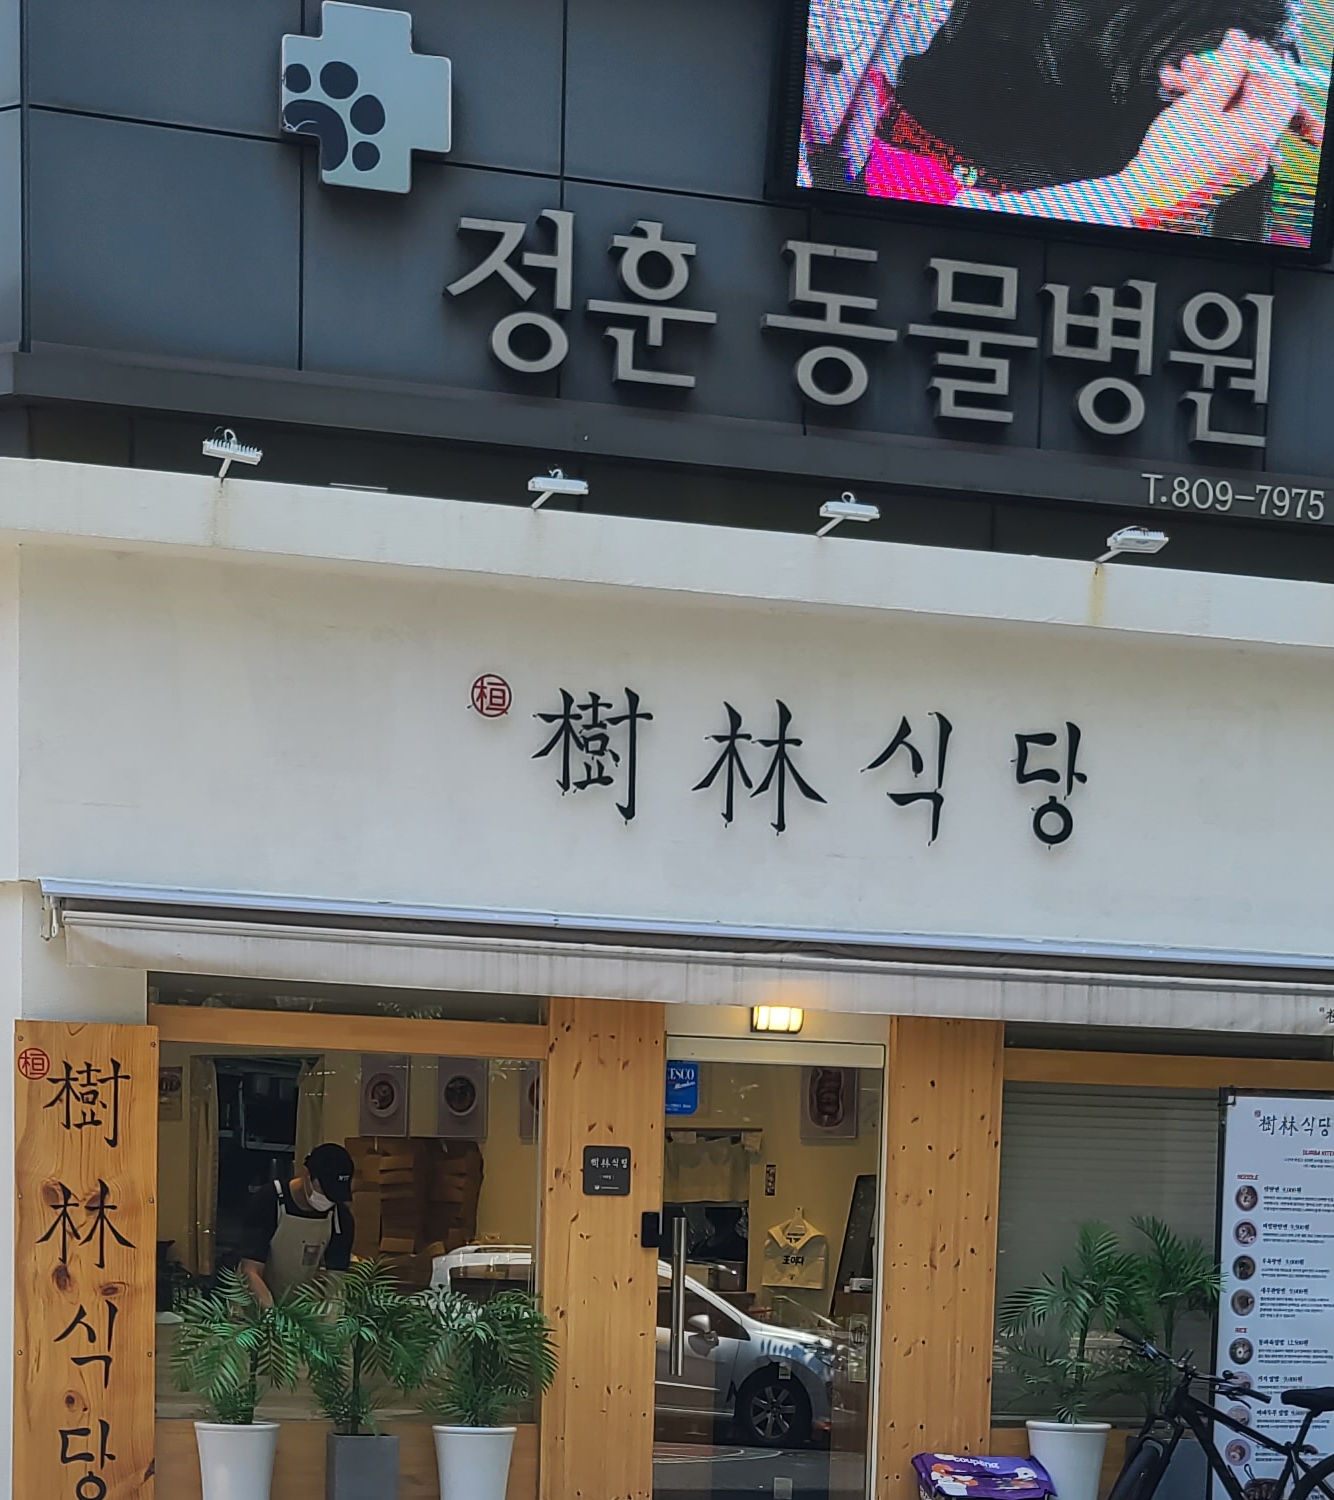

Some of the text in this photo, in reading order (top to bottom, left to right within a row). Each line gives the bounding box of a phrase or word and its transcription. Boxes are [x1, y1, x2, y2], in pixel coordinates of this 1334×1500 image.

[445, 208, 1275, 448] 정훈 동물병원
[1142, 472, 1326, 520] T.809-7975
[531, 686, 1089, 847] 樹林식당
[1258, 1114, 1331, 1137] 樹林식당
[953, 1456, 1001, 1470] coupang
